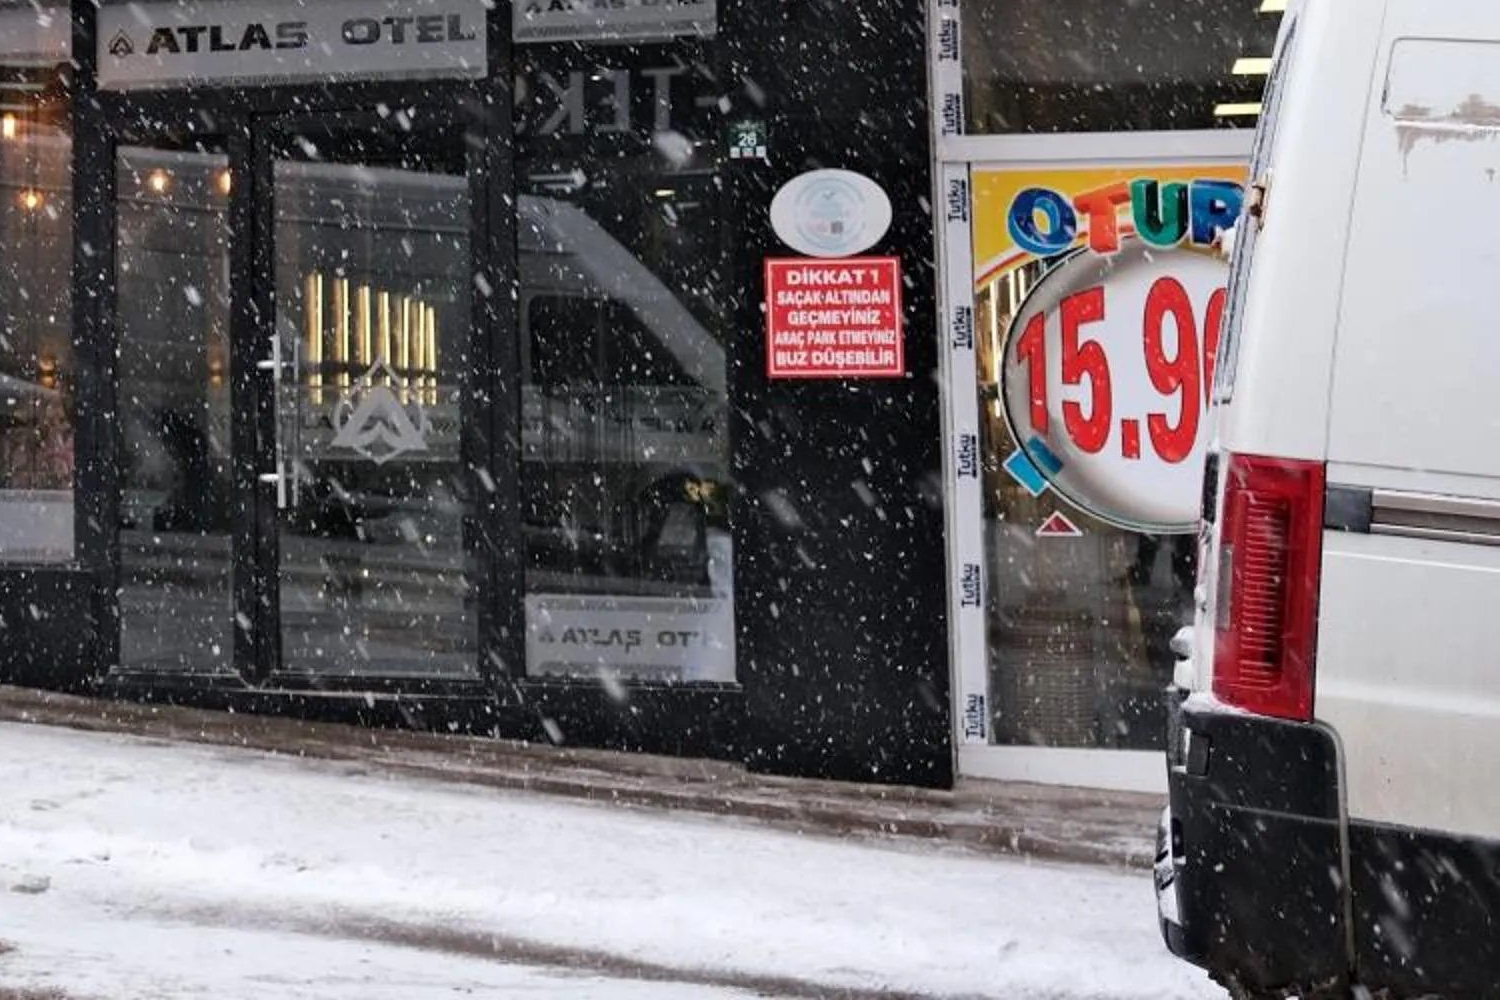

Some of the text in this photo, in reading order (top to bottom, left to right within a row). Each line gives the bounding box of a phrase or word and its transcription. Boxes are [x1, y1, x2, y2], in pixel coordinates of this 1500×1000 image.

[146, 13, 476, 55] ATLAS OTEL
[938, 19, 951, 62] Tutku
[942, 93, 954, 137] Tutku
[948, 179, 961, 223] Tutku
[786, 267, 865, 285] DİKKAT
[777, 289, 890, 307] SAÇAK ALTINDAN
[787, 307, 881, 328] GEÇMEYİNİZ
[775, 327, 895, 348] ARAÇ PARK ETMEYİNİZ
[954, 306, 966, 350] Tutku
[776, 347, 895, 368] BUZ DÜŞEBİLİR
[958, 434, 970, 478] Tutku
[961, 564, 974, 608] Tutku
[965, 694, 978, 738] Tutku
